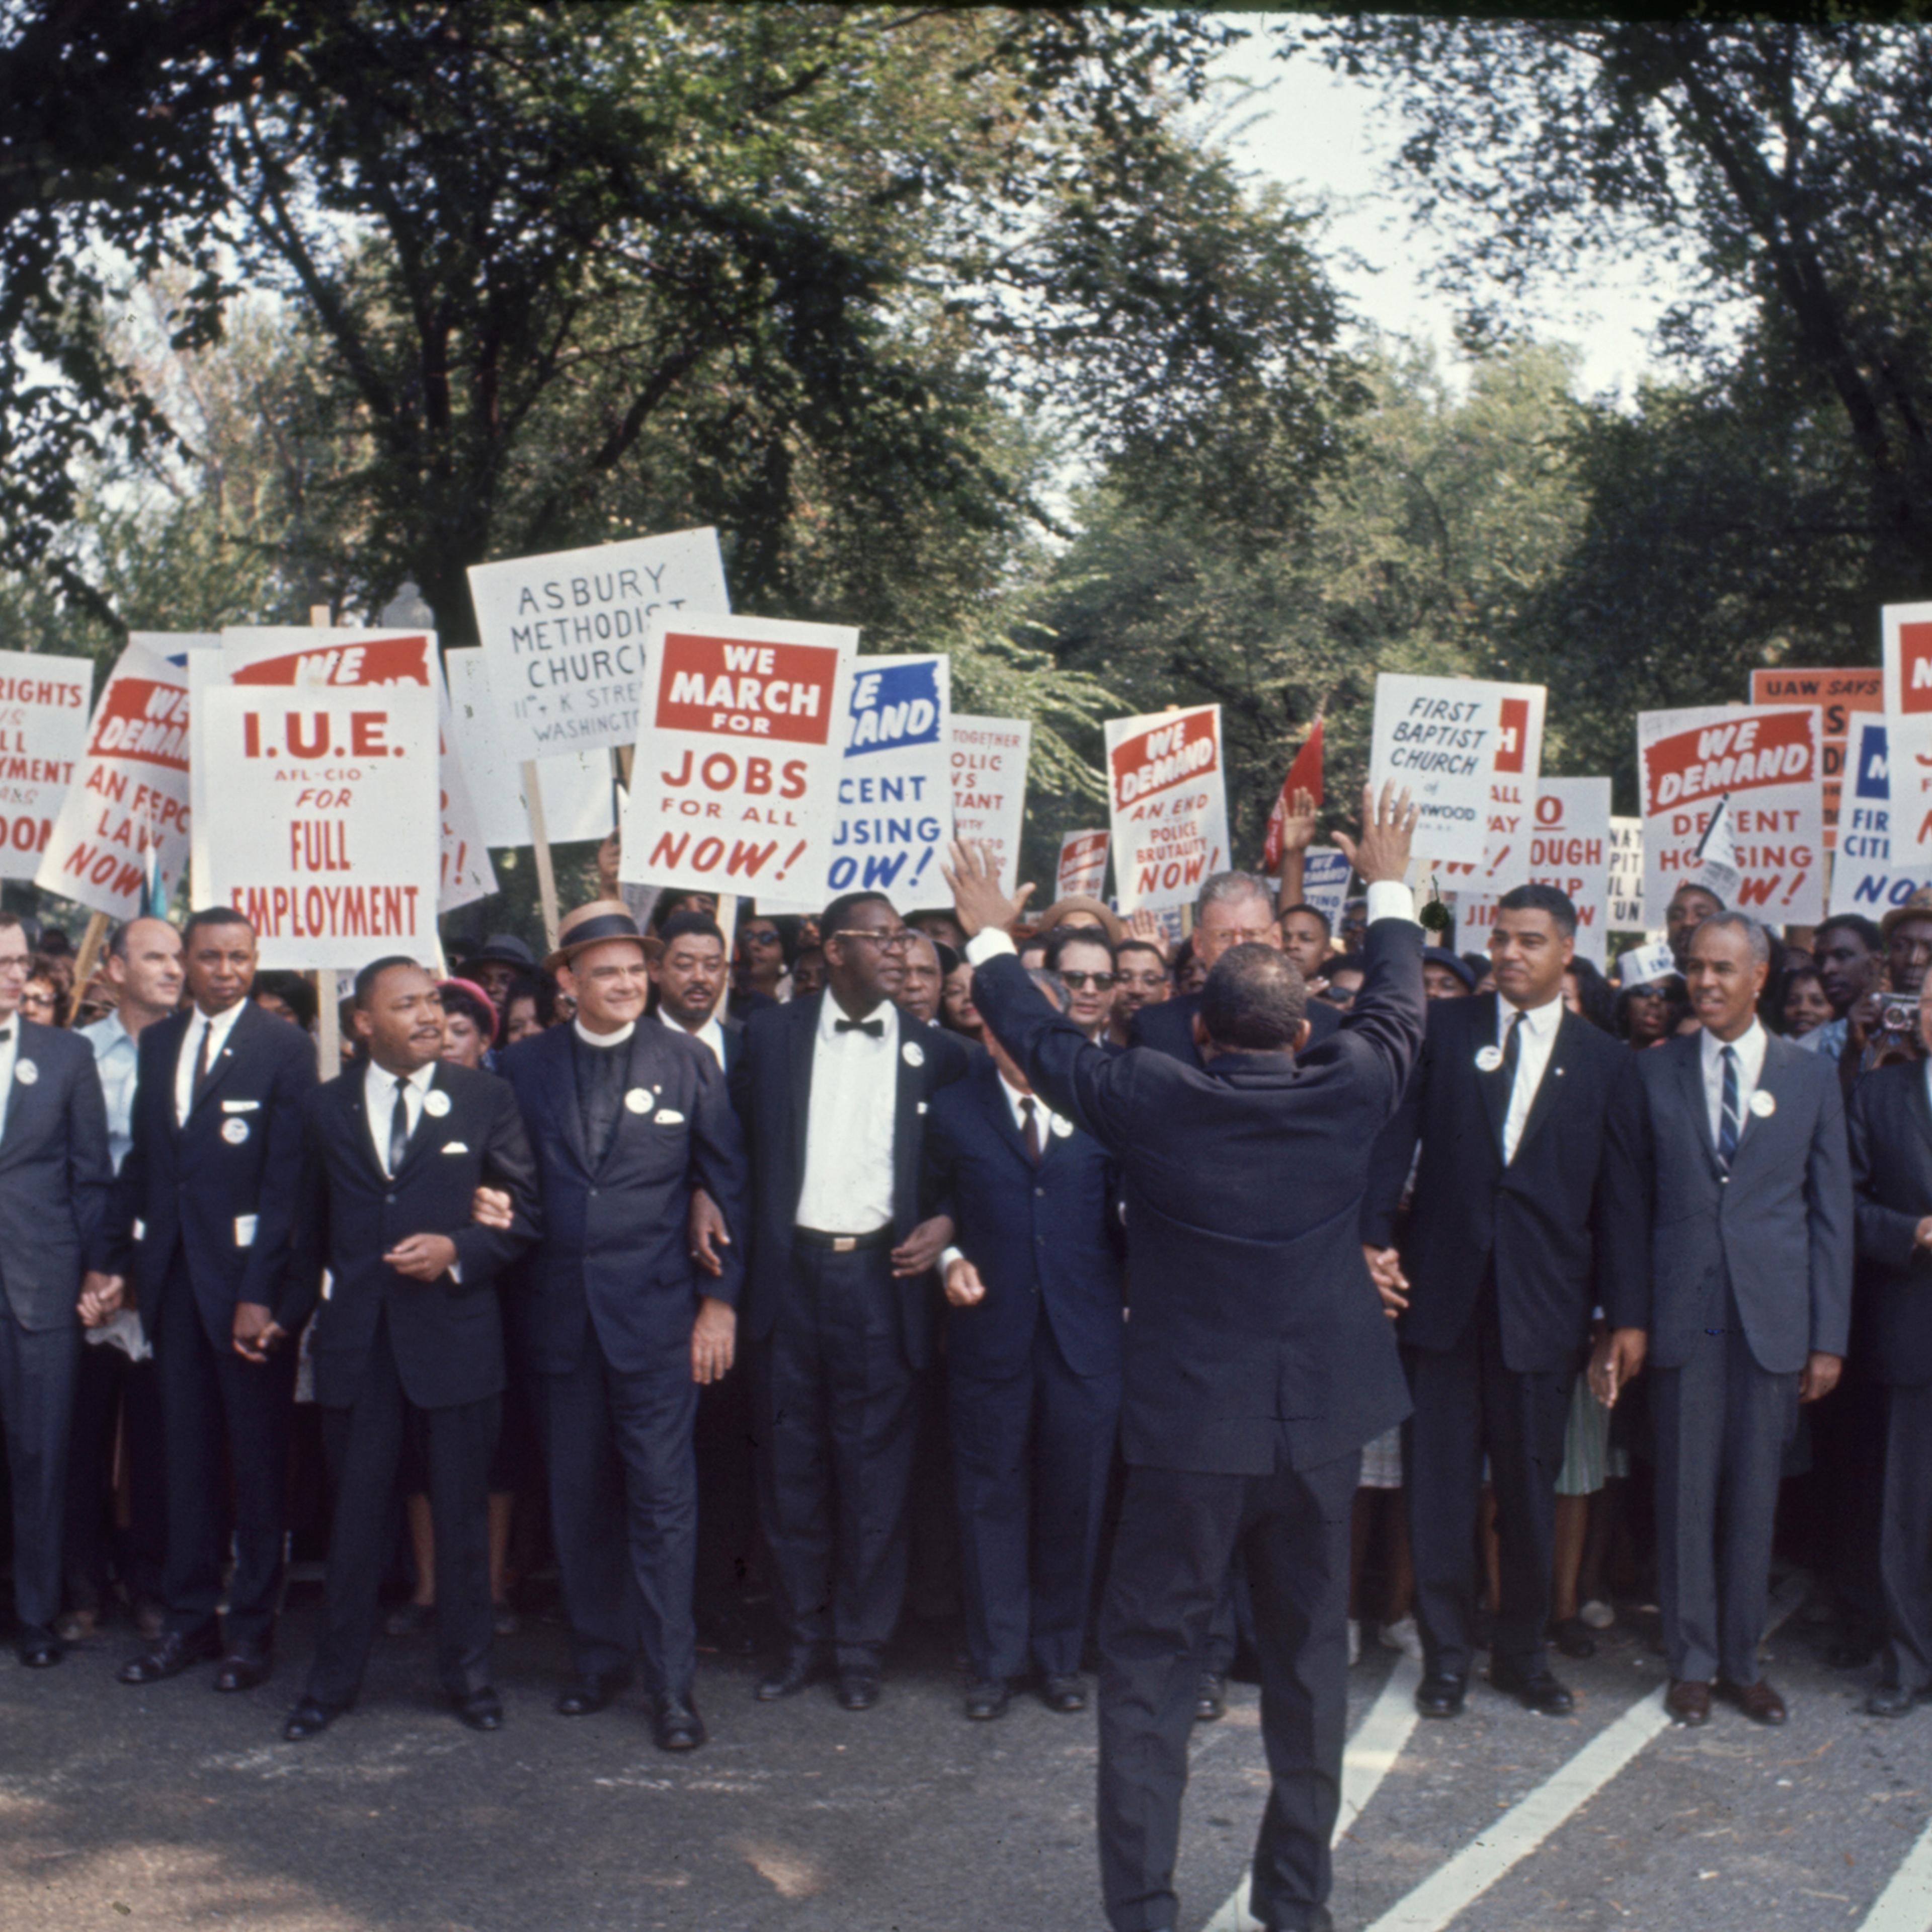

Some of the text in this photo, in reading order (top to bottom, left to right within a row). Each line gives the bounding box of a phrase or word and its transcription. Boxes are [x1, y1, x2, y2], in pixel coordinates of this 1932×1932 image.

[519, 563, 666, 615] ASBURY
[295, 648, 365, 685] WE
[723, 645, 776, 675] WE
[586, 681, 643, 708] STRE
[669, 671, 821, 717] MARCH
[854, 673, 882, 709] E
[1766, 680, 1880, 695] UAW SAYS
[712, 712, 770, 734] FOR
[1409, 697, 1481, 722] FIRST
[245, 711, 405, 759] I.U.E.
[952, 728, 1021, 748] TOGETHER
[1146, 722, 1185, 761] WE
[1393, 721, 1486, 749] BAPTIST
[1698, 720, 1759, 760] WE
[661, 750, 808, 799] JOBS
[950, 752, 1002, 772] OLIC
[1120, 737, 1213, 802] DEMAND
[1390, 747, 1478, 775] CHURCH
[1656, 744, 1809, 804] DEMAND
[85, 763, 190, 835] AN FEPC
[296, 789, 352, 808] FOR
[953, 791, 1004, 810] TANT
[1131, 794, 1209, 822] AN END
[1490, 785, 1521, 803] ALL
[661, 797, 797, 827] FOR ALL
[1488, 815, 1520, 833] AY
[1673, 811, 1800, 836] DEENT
[97, 808, 164, 853] LAW
[1150, 821, 1196, 844] POLICE
[290, 820, 350, 871] FULL
[649, 830, 808, 879] NOW!
[1136, 837, 1206, 864] BRUTALITY
[1660, 846, 1812, 870] HOSING
[231, 886, 417, 937] EMPLOYMENT
